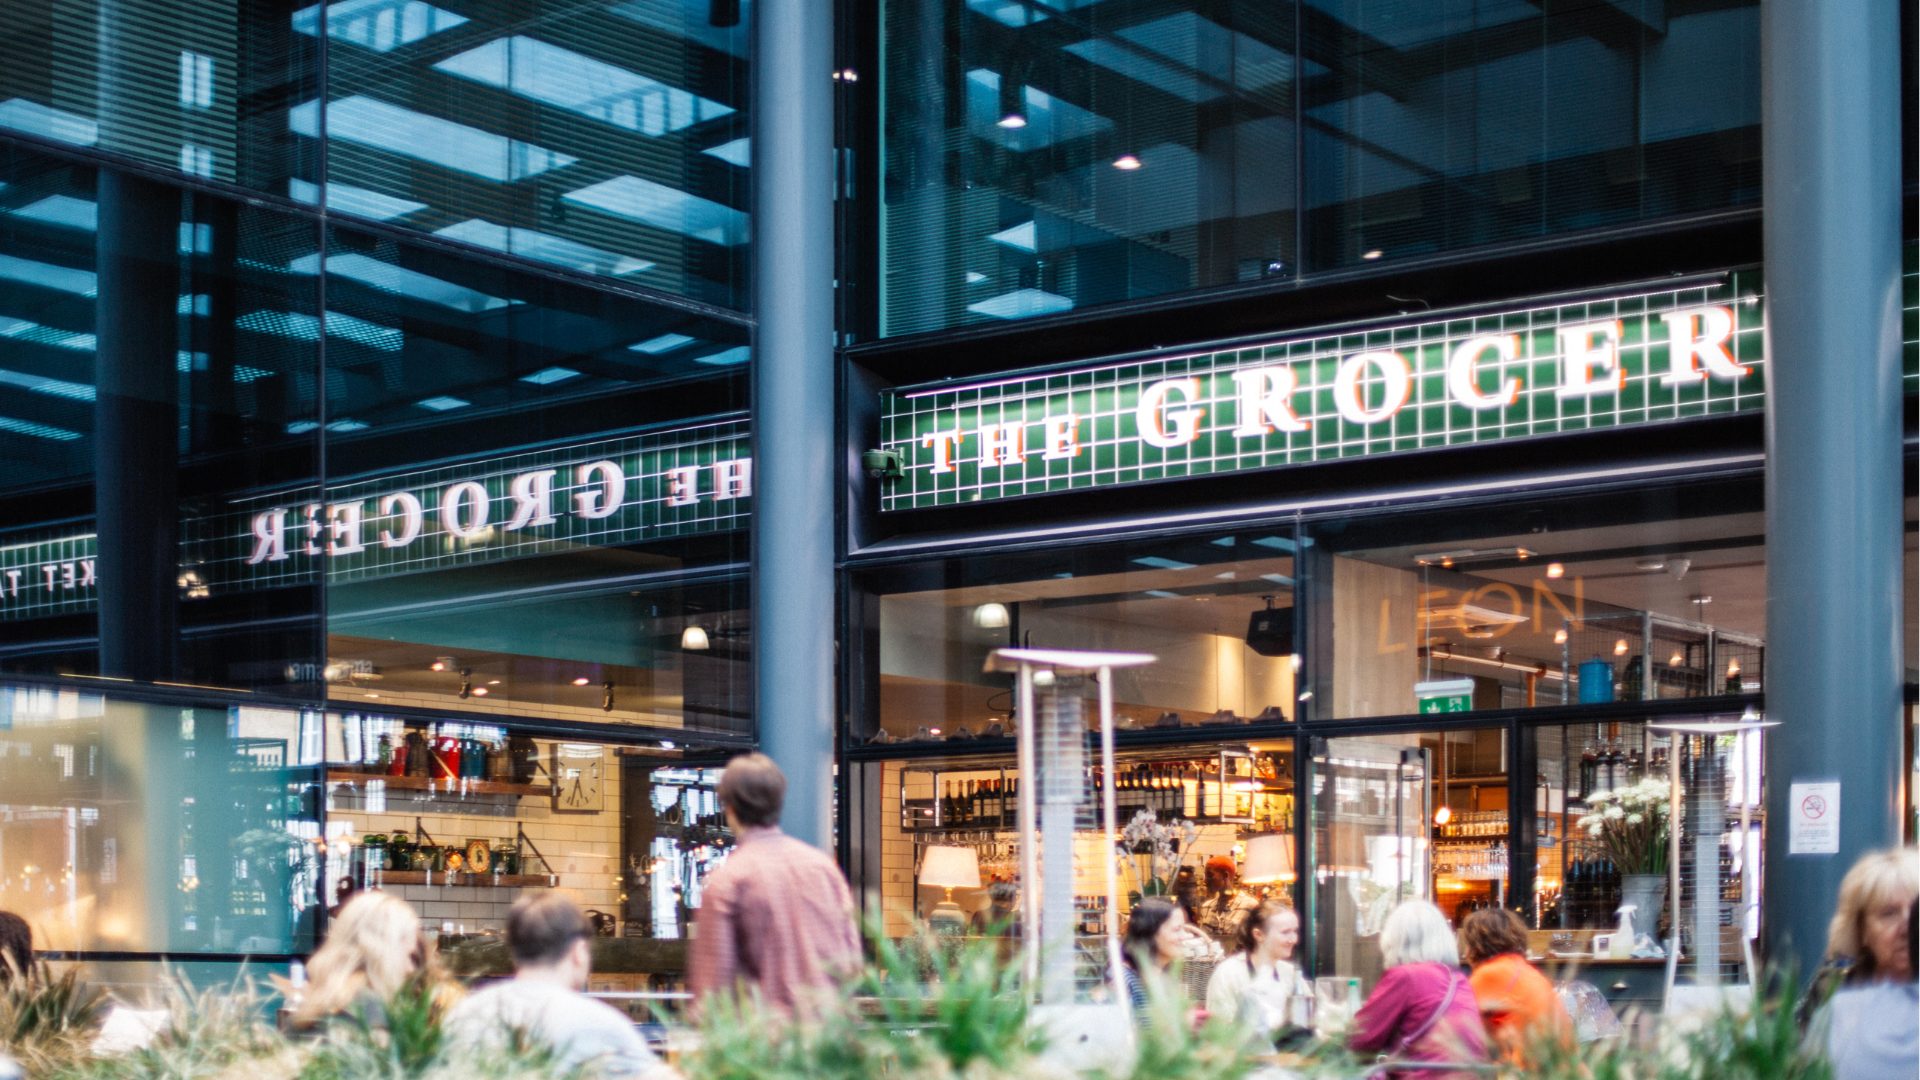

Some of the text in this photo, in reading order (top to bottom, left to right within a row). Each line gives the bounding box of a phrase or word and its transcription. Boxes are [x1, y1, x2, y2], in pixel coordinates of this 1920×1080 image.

[921, 305, 1754, 475] THE GROCER
[1376, 575, 1585, 655] LEON
